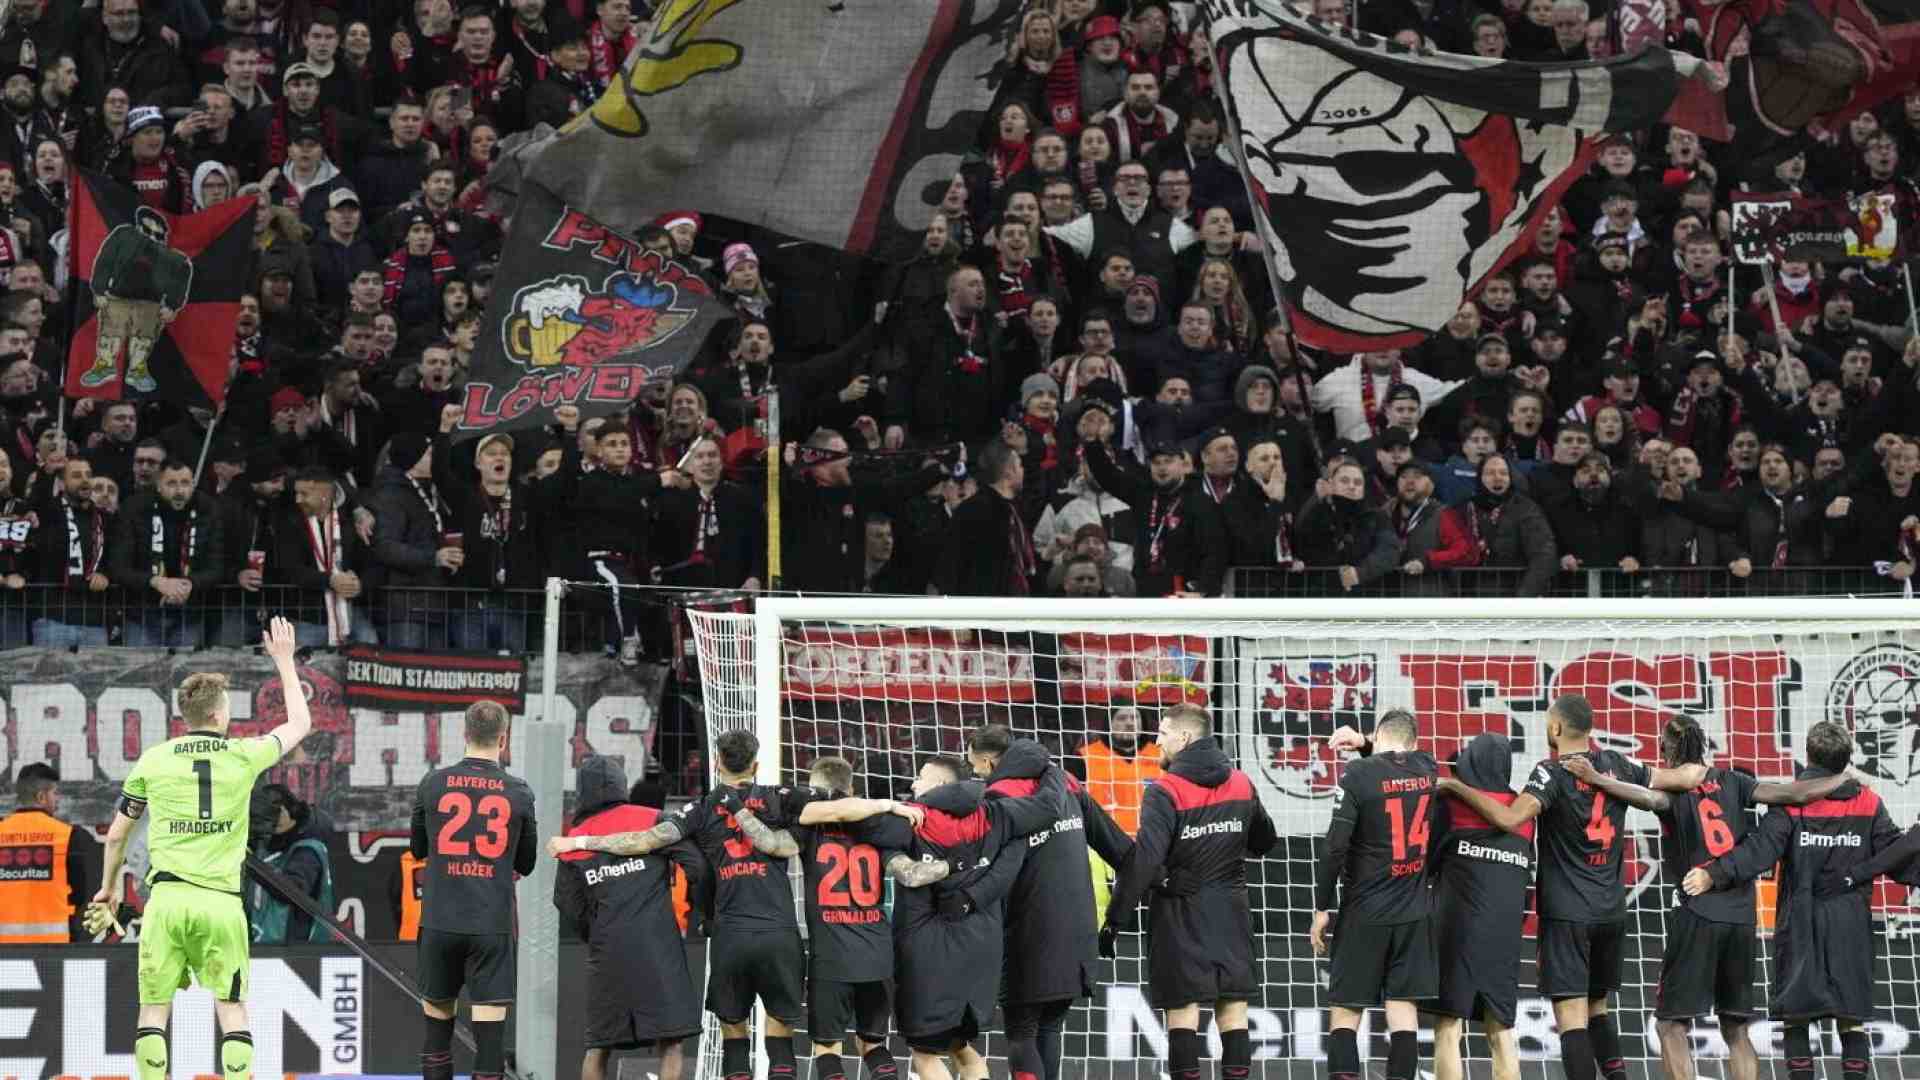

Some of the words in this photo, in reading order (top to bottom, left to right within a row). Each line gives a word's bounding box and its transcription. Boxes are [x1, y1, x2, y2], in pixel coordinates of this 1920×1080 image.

[1321, 106, 1372, 120] 2006
[347, 660, 402, 686] SEKTION
[405, 667, 522, 691] STADIONVERBOT
[192, 759, 212, 819] 1
[169, 820, 233, 834] HRADECKY
[437, 791, 512, 858] 23
[1180, 817, 1244, 841] Barmenia
[1385, 794, 1431, 860] 14
[1585, 790, 1616, 850] 4
[1697, 797, 1735, 857] 6
[447, 861, 495, 877] HLOŽEK
[816, 843, 881, 906] 20
[1391, 860, 1424, 877] SCHIC
[1457, 839, 1529, 868] Barmenia
[332, 972, 358, 1064] GMBH
